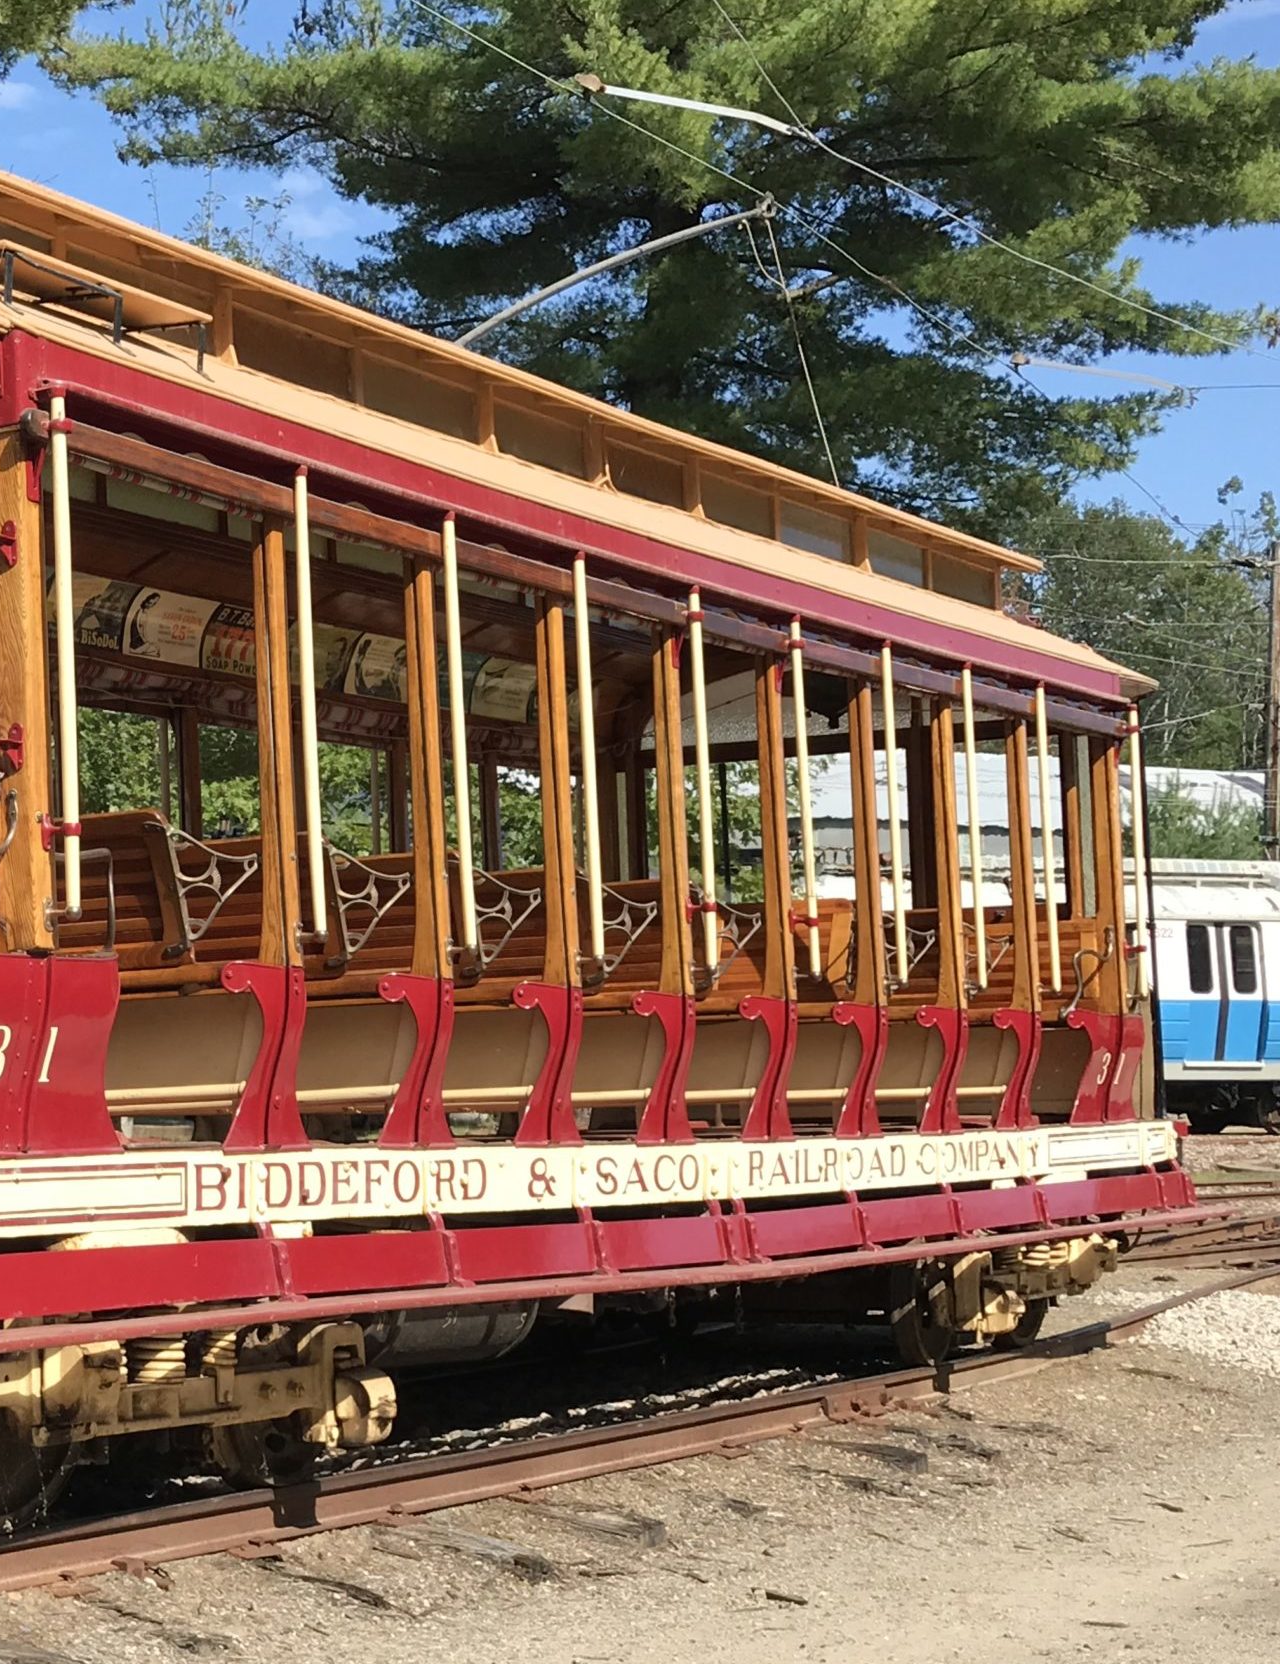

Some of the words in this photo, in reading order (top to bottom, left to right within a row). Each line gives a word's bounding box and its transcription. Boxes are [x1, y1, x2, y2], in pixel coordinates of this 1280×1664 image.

[210, 626, 256, 662] 177
[206, 655, 229, 670] SOAP
[1097, 1052, 1126, 1084] 31
[194, 1158, 488, 1212] BIDDEFORD
[527, 1157, 556, 1199] &
[595, 1153, 700, 1196] SACO
[748, 1143, 906, 1187] RAILROAD
[920, 1138, 1041, 1176] COMPANY
